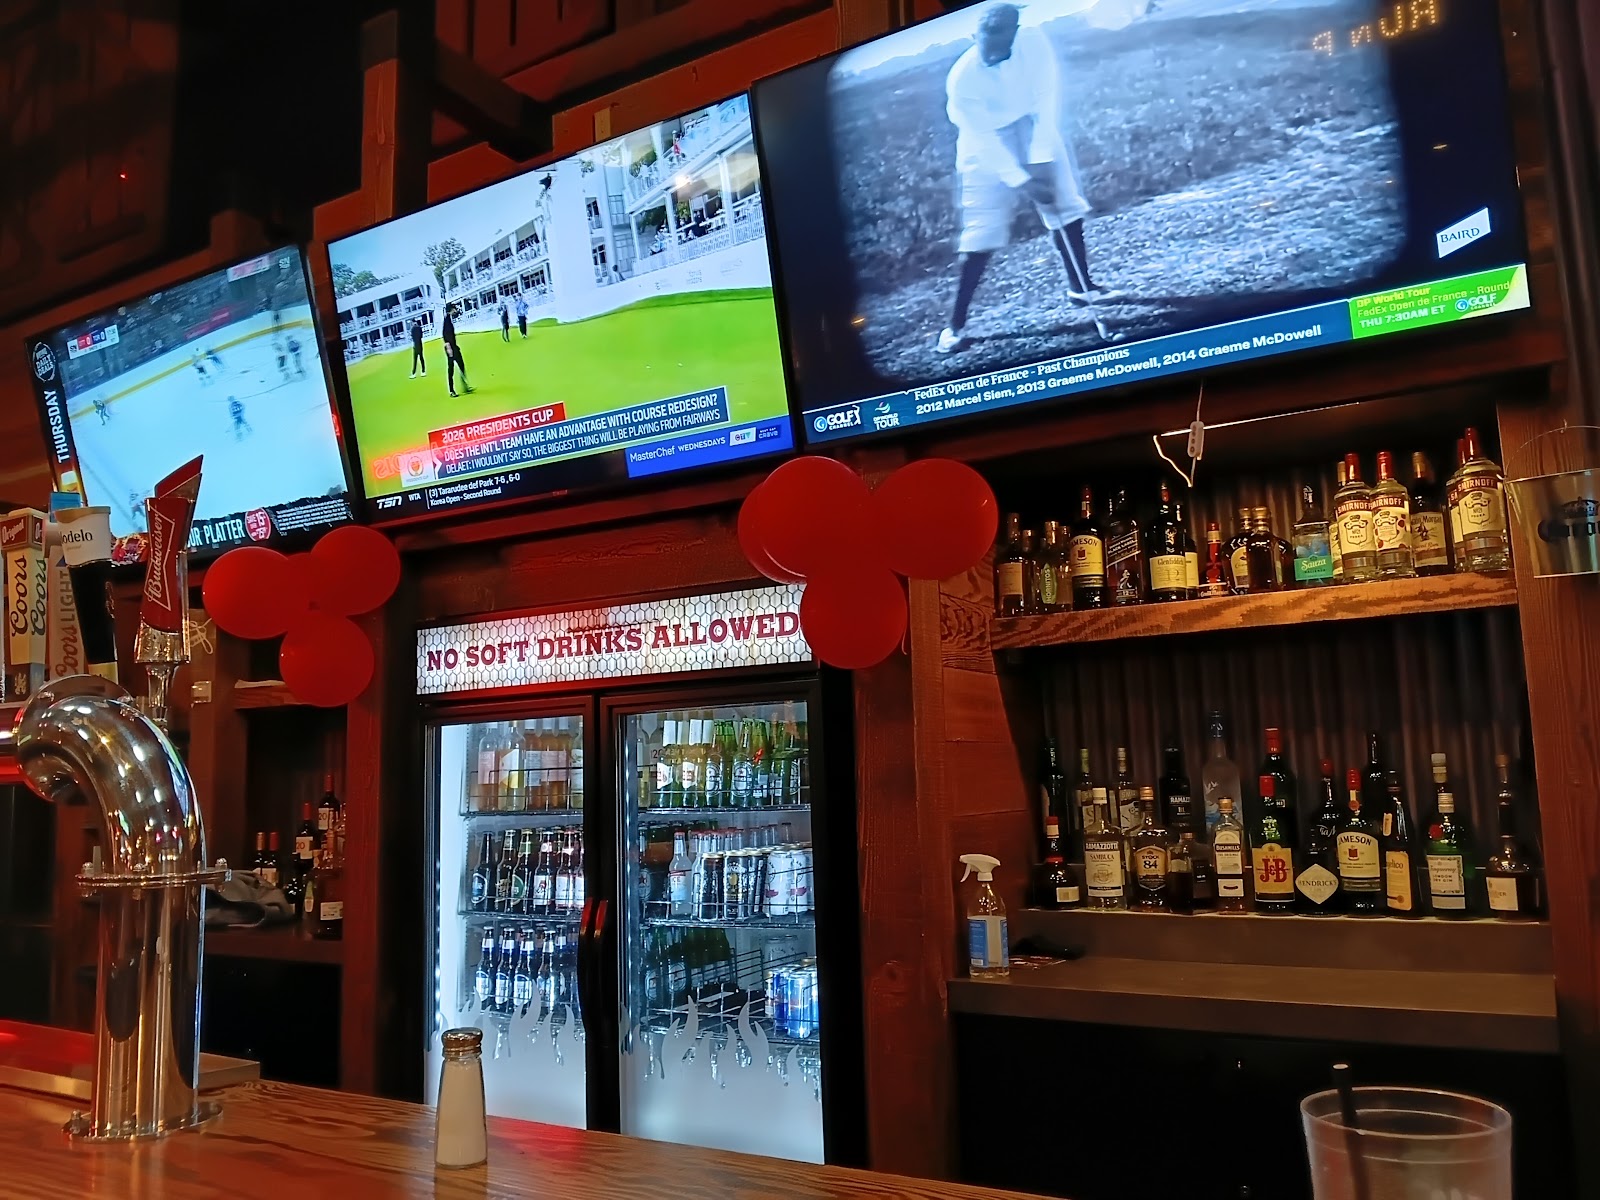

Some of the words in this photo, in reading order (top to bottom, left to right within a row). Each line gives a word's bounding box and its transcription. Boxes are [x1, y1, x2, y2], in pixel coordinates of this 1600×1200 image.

[1440, 227, 1480, 243] BAIRD
[1356, 298, 1371, 308] DP
[1373, 291, 1405, 305] World
[1407, 287, 1431, 298] Tour
[1357, 305, 1388, 317] FedEx
[1390, 301, 1416, 314] Open
[1417, 297, 1430, 307] de
[1432, 290, 1467, 304] France
[1477, 281, 1510, 295] Round
[1468, 293, 1496, 306] GOLF
[1358, 316, 1382, 329] THU
[1385, 308, 1429, 324] 7:30AM
[1431, 305, 1446, 315] ET
[914, 388, 946, 401] FedEx
[947, 381, 975, 396] Open
[975, 376, 990, 388] de
[991, 369, 1029, 386] France
[1037, 362, 1061, 376] Past
[1063, 348, 1130, 372] Champions
[916, 401, 944, 415] 2012
[944, 394, 982, 410] Marcel
[983, 386, 1016, 402] Siem,
[1016, 380, 1046, 395] 2013
[1048, 371, 1094, 389] Graeme
[1096, 354, 1161, 379] McDowell,
[1163, 349, 1197, 366] 2014
[1199, 340, 1251, 358] Graeme
[1252, 324, 1322, 348] McDowell
[44, 390, 70, 464] THURSDAY
[442, 429, 465, 443] 2026
[466, 413, 531, 438] PRESIDENTS
[532, 408, 554, 424] CUP
[444, 448, 464, 462] DOES
[465, 444, 482, 457] THE
[482, 441, 501, 455] INT'L
[500, 437, 524, 450] TEAM
[523, 431, 546, 445] HAVE
[545, 428, 557, 441] AN
[558, 417, 608, 435] ADVANTAGE
[607, 412, 631, 428] WITH
[632, 404, 667, 423] COURSE
[668, 393, 718, 415] REDESIGN?
[827, 410, 855, 426] GOLF
[874, 418, 900, 431] TOUR
[509, 450, 521, 461] SAY
[534, 444, 548, 456] THE
[548, 438, 576, 453] BIGGEST
[576, 433, 599, 448] THING
[599, 430, 618, 443] WILL
[618, 427, 629, 439] BE
[629, 420, 660, 438] PLAYING
[661, 416, 683, 433] FROM
[682, 408, 720, 428] FAIRWAYS
[630, 446, 675, 463] MasterChef
[677, 436, 726, 453] WEDNESDAYS
[408, 492, 421, 502] WTA
[429, 488, 438, 499] (3)
[479, 478, 495, 488] Park
[430, 497, 446, 507] Korea
[446, 494, 461, 505] Open
[463, 489, 484, 501] Second
[483, 487, 502, 498] Round
[1458, 478, 1495, 492] SMIRNOFF
[376, 496, 402, 509] TSN
[1371, 497, 1402, 510] MIRNOFF
[204, 518, 246, 545] PLATTER
[147, 511, 164, 603] Budweiser
[1301, 558, 1327, 571] Sauza
[10, 554, 28, 637] Coors
[30, 557, 48, 636] Coors
[59, 570, 77, 623] LIGHT
[426, 648, 459, 672] NO
[466, 640, 529, 668] SOFT
[537, 628, 643, 660] DRINKS
[651, 611, 799, 649] ALLOWED
[1215, 844, 1240, 852] BUSHMILLS
[1339, 835, 1372, 846] JAMESON
[1143, 860, 1158, 870] 84
[1259, 858, 1288, 883] J&B
